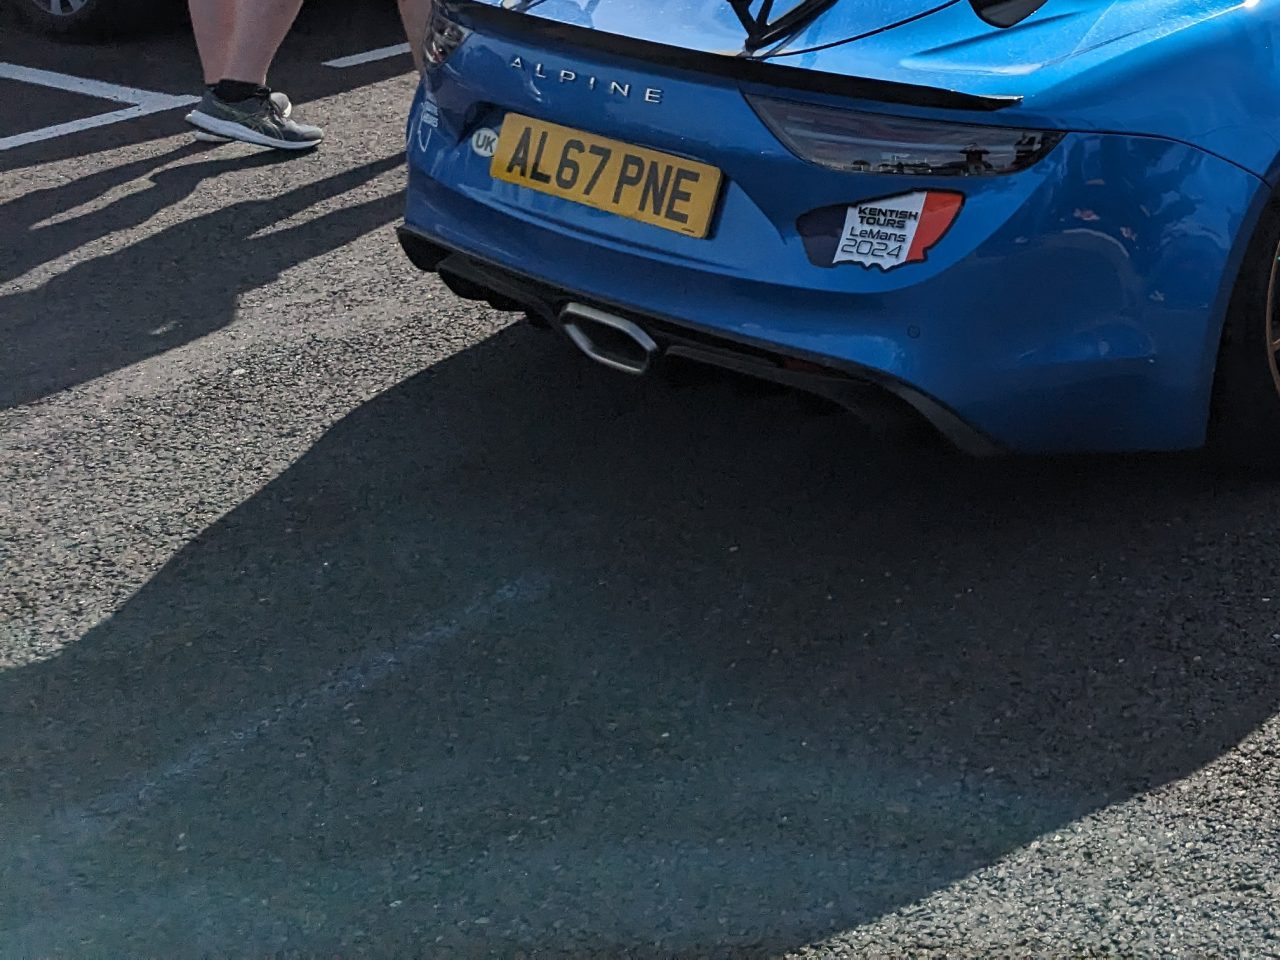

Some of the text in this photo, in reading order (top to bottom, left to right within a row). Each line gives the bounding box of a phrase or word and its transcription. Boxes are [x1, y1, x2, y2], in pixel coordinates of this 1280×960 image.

[511, 57, 662, 103] ALPINE
[475, 132, 497, 153] UK
[507, 127, 700, 223] AL67 PNE
[858, 206, 919, 221] KENTISH
[859, 215, 906, 228] TOURS
[850, 226, 907, 243] LeMans
[840, 238, 903, 259] 2024
